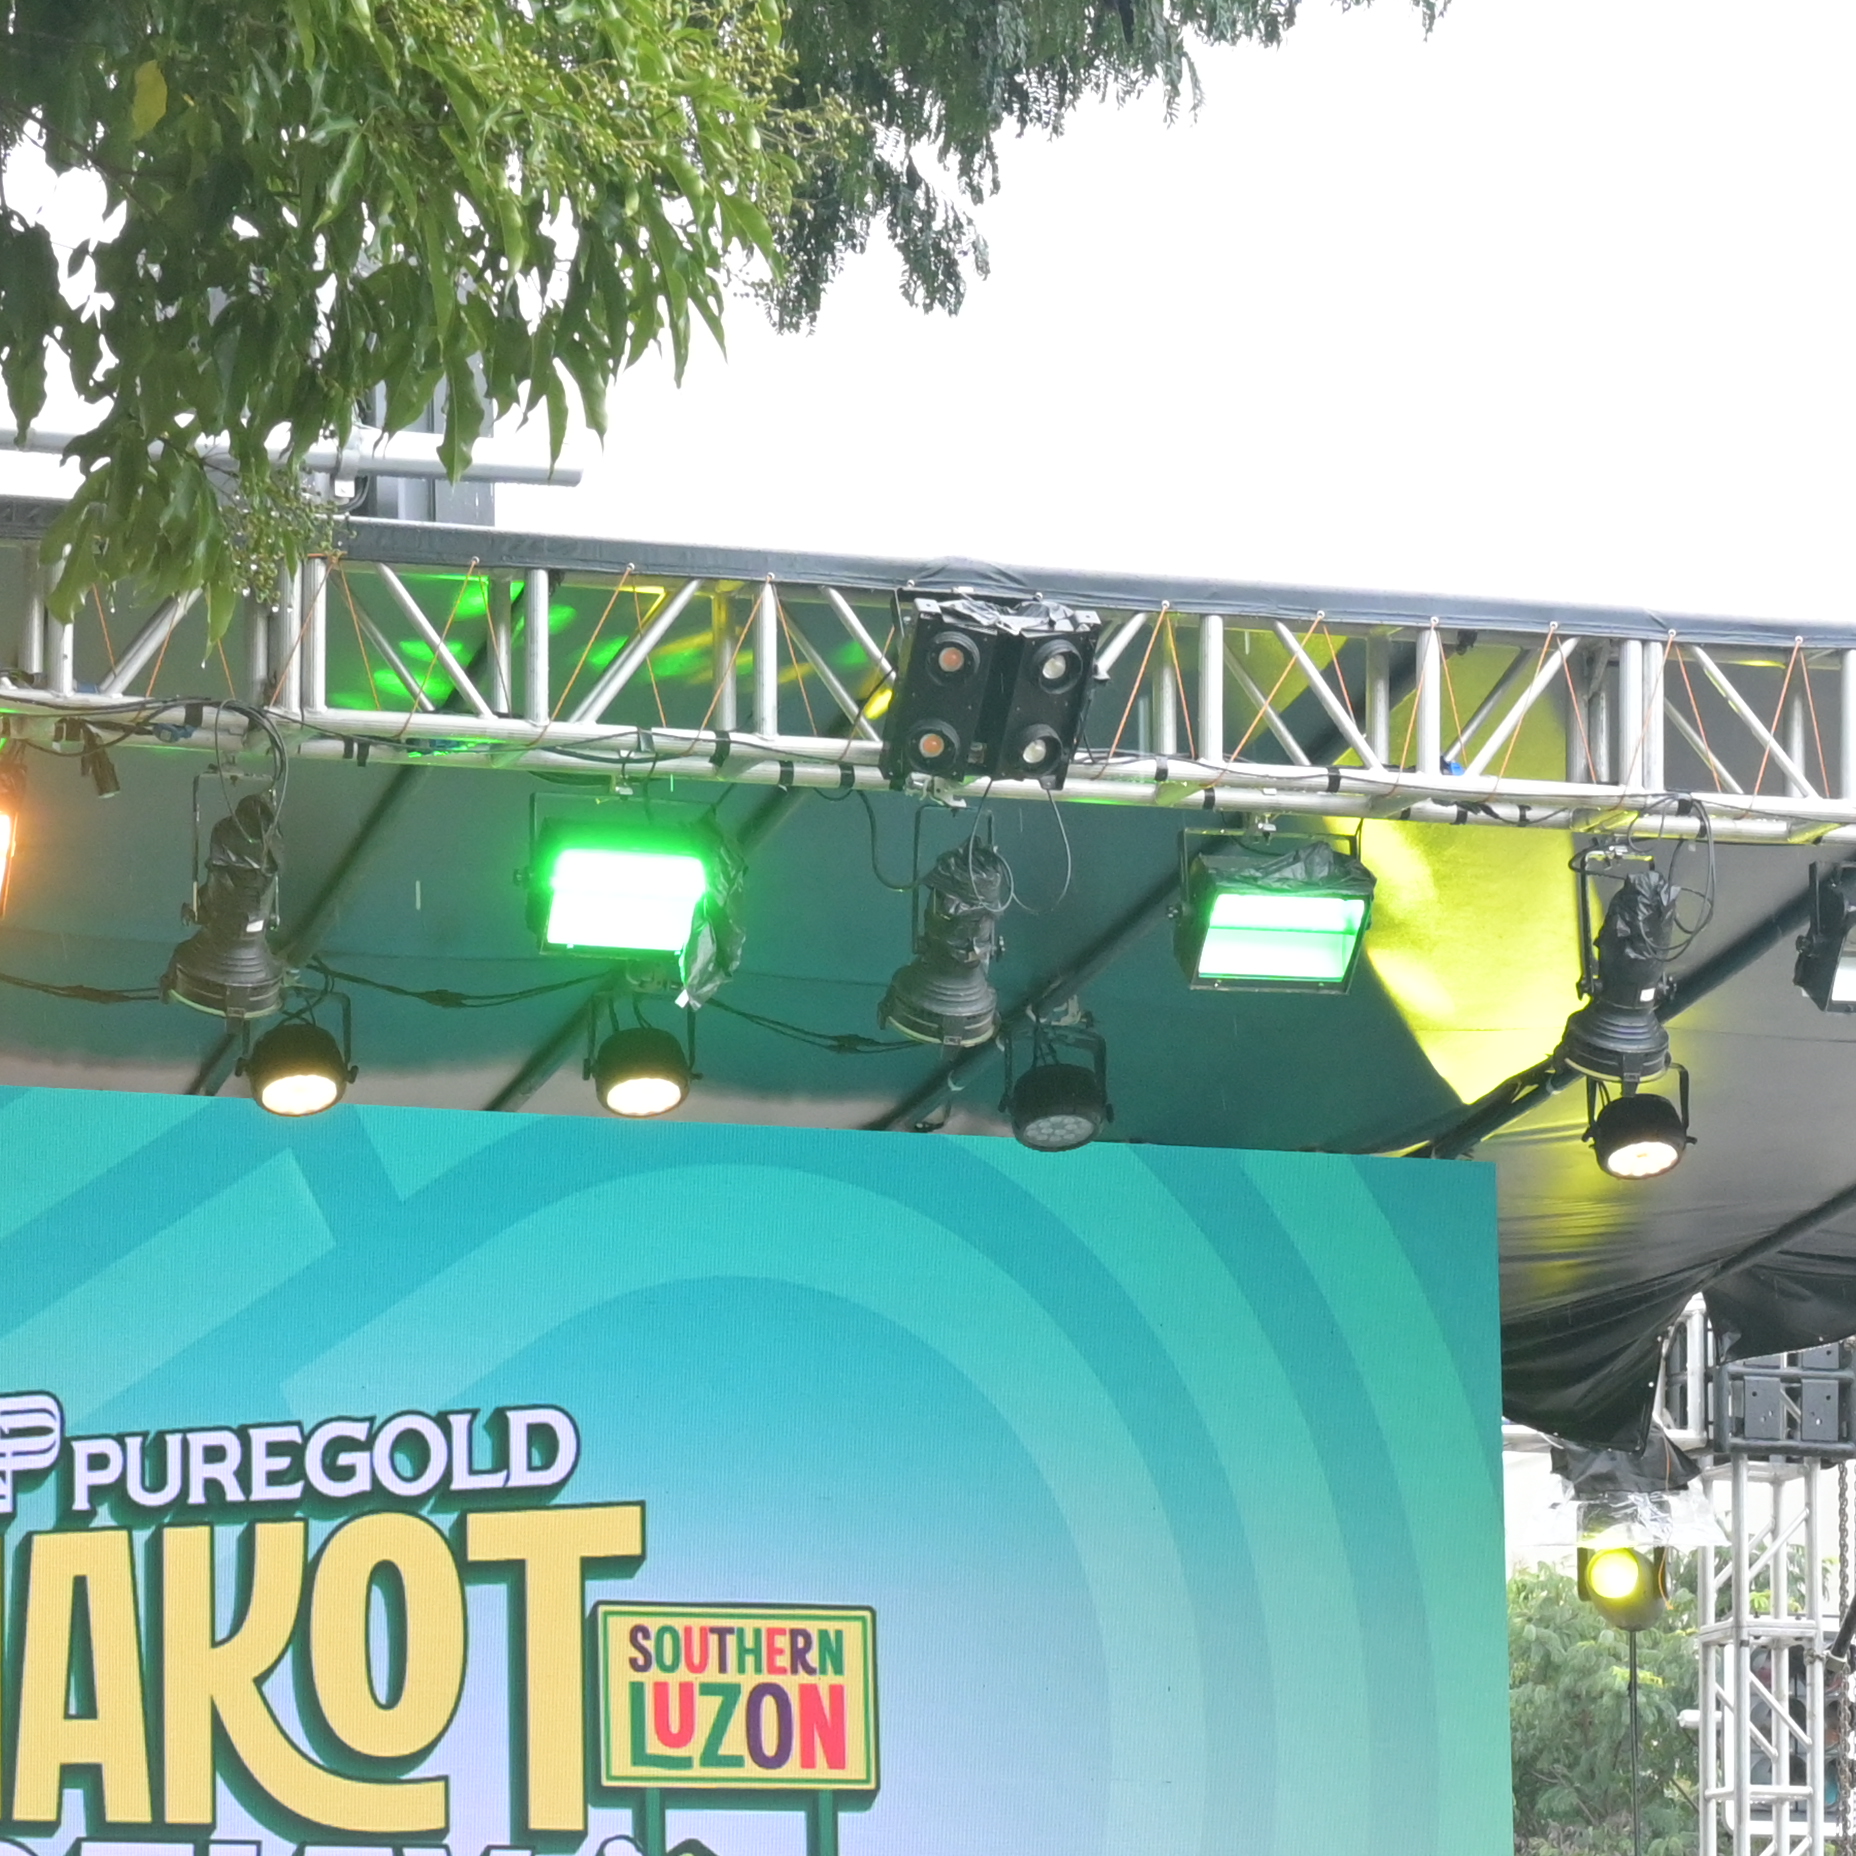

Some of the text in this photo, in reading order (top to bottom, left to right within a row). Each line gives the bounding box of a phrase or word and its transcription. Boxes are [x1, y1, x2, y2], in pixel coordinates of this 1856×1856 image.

[70, 1405, 581, 1514] PUREGOLD
[627, 1622, 846, 1676] SOUTHERN
[630, 1678, 848, 1773] LUZON
